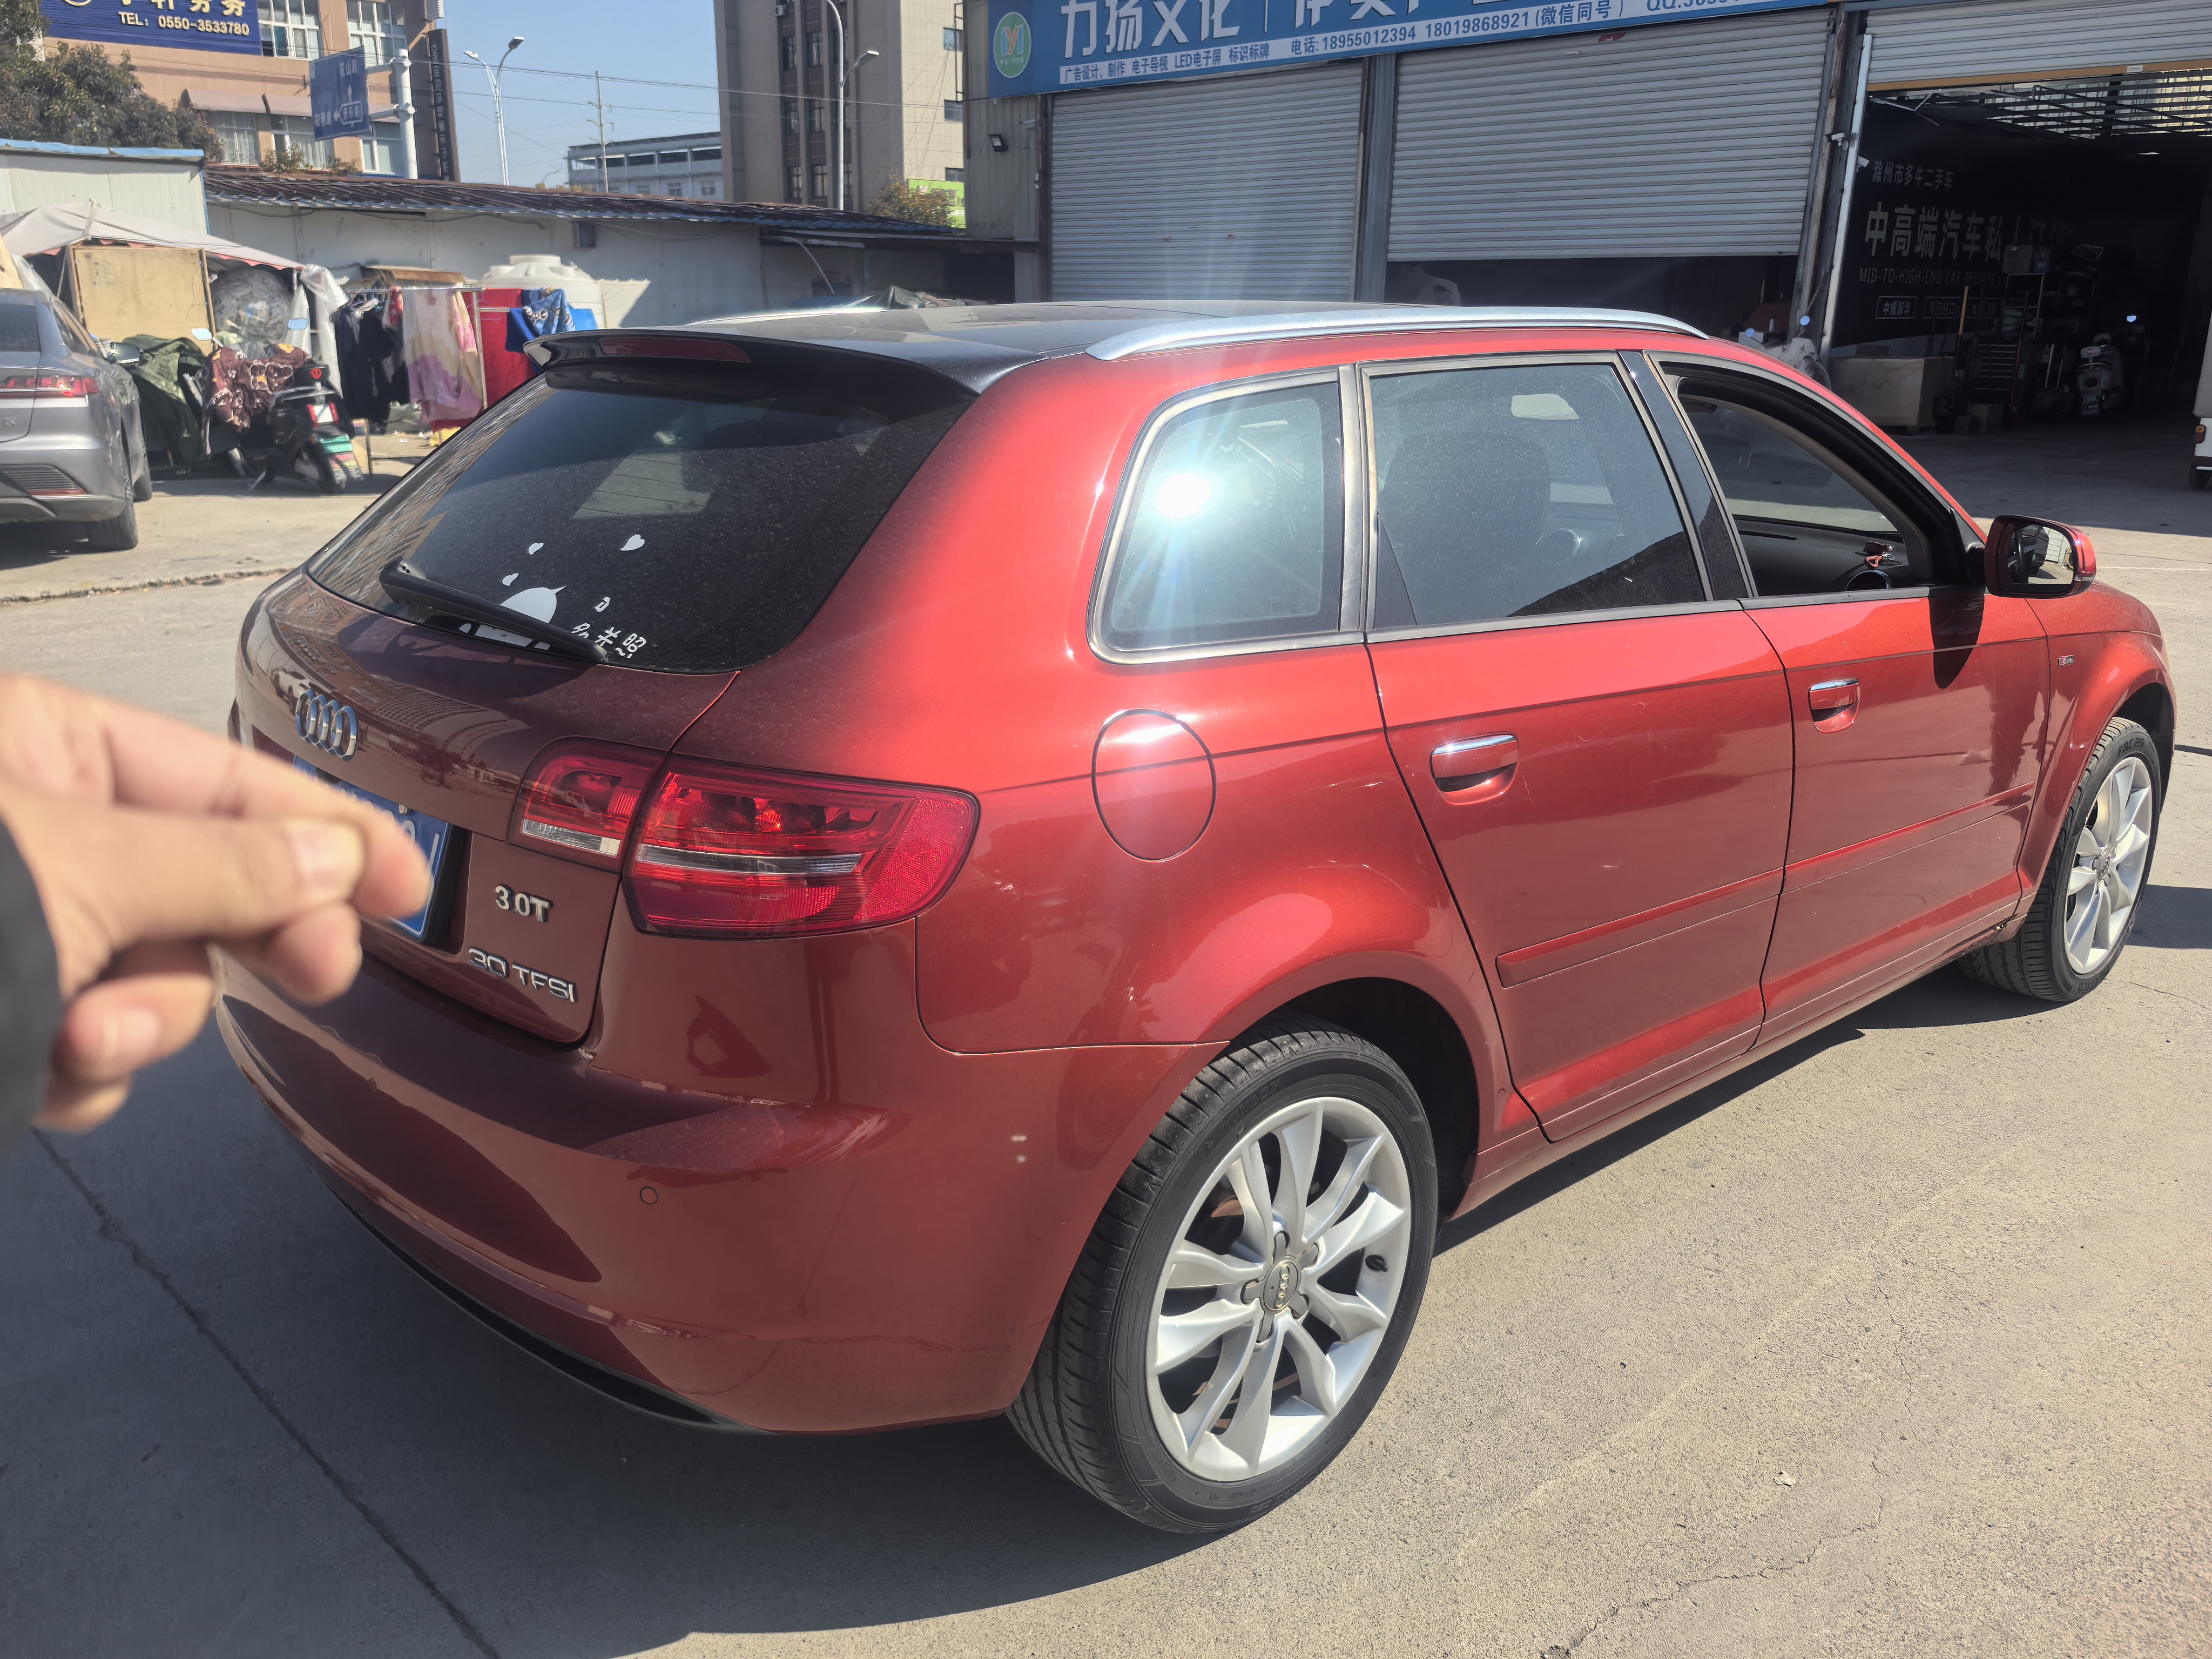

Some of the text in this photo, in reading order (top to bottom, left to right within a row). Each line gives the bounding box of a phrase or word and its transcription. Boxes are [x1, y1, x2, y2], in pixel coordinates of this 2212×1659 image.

[1061, 0, 1240, 58] 力扬文化
[1174, 49, 1222, 69] LED电子屏
[1425, 12, 1528, 39] 18019868921
[469, 947, 577, 1003] 30 TFSI
